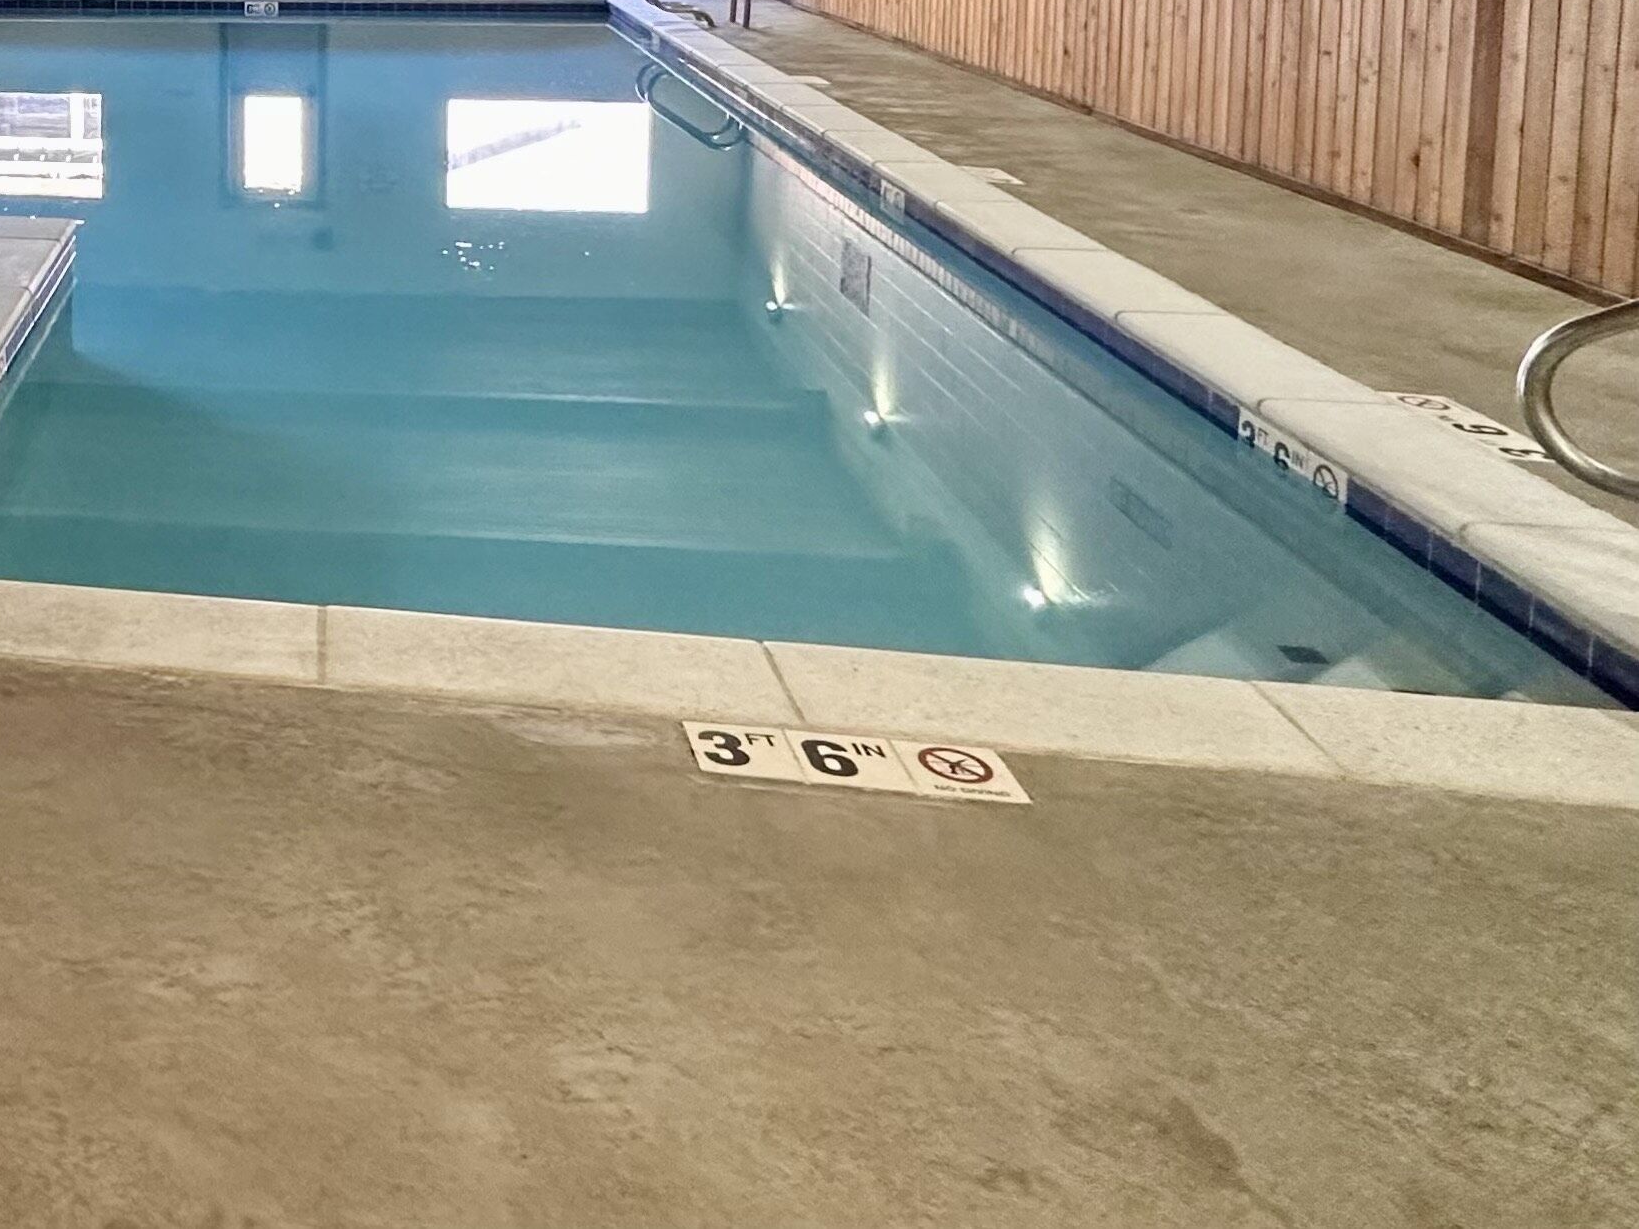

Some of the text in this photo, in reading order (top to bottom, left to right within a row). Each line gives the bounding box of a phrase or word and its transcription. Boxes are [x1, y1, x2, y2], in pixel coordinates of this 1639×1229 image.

[698, 730, 887, 777] 3 FT 6 IN
